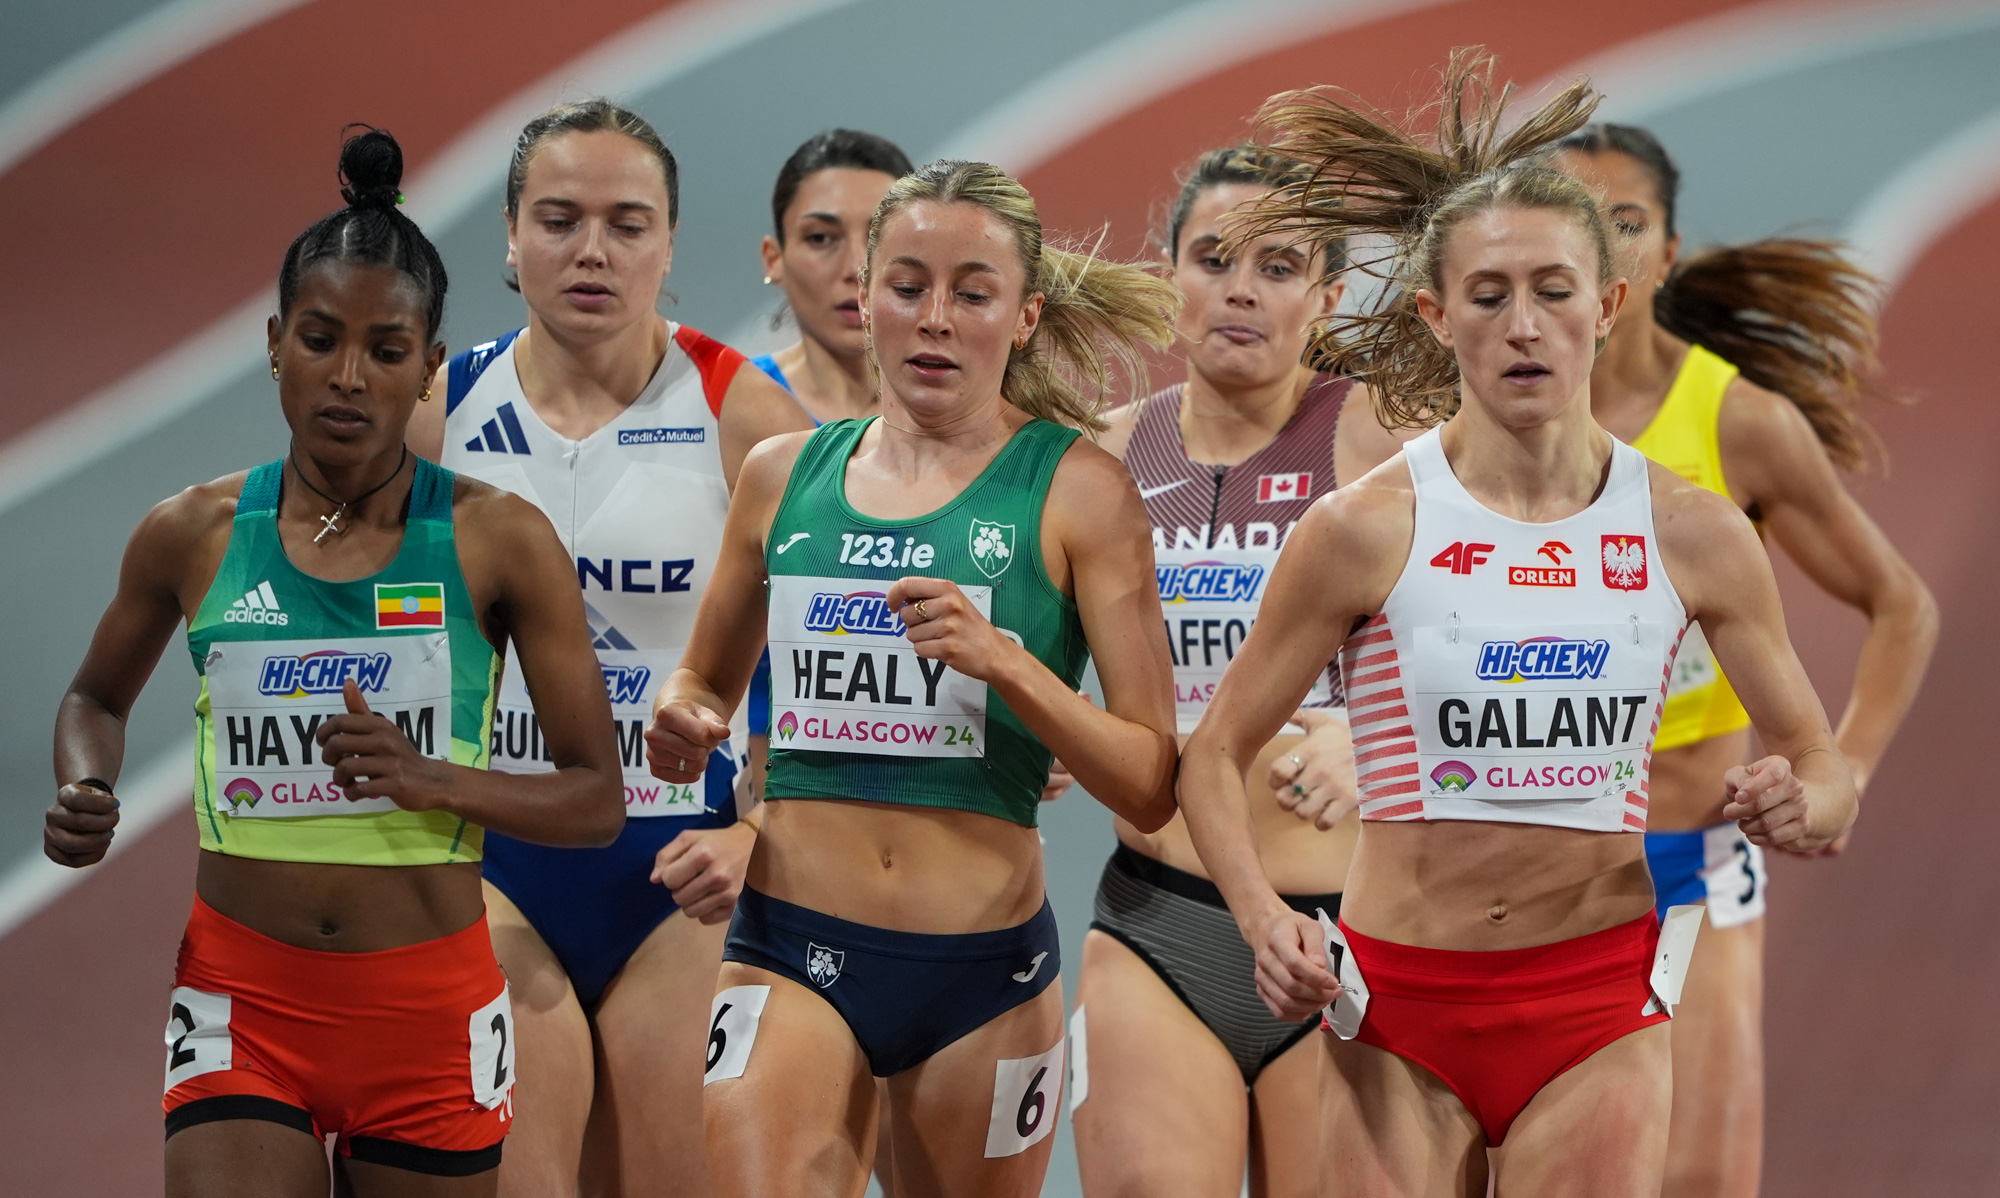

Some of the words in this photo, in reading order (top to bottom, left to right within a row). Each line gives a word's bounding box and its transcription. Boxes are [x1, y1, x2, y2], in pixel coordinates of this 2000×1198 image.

[620, 431, 653, 444] Crédit
[666, 430, 704, 442] Mutuel
[839, 533, 935, 568] 123.ie
[1152, 521, 1298, 550] ANAD
[577, 557, 694, 593] NCE
[1430, 541, 1496, 575] 4F
[1512, 568, 1572, 585] ORLEN
[224, 606, 289, 626] adidas
[1165, 618, 1256, 666] FFO
[1476, 639, 1610, 680] HI-CHEW
[258, 652, 392, 696] HI-CHEW
[792, 649, 948, 707] HEALY
[226, 706, 435, 767] HAYM
[804, 717, 938, 745] GLASGOW
[944, 725, 974, 745] 24
[1438, 696, 1647, 748] GALANT
[1486, 761, 1613, 788] GLASGOW
[1614, 759, 1635, 780] 24
[666, 784, 694, 805] 24
[1733, 839, 1755, 906] 3
[170, 1002, 196, 1072] 2
[490, 1013, 508, 1090] 2
[705, 1003, 733, 1075] 6
[1016, 1066, 1049, 1138] 6
